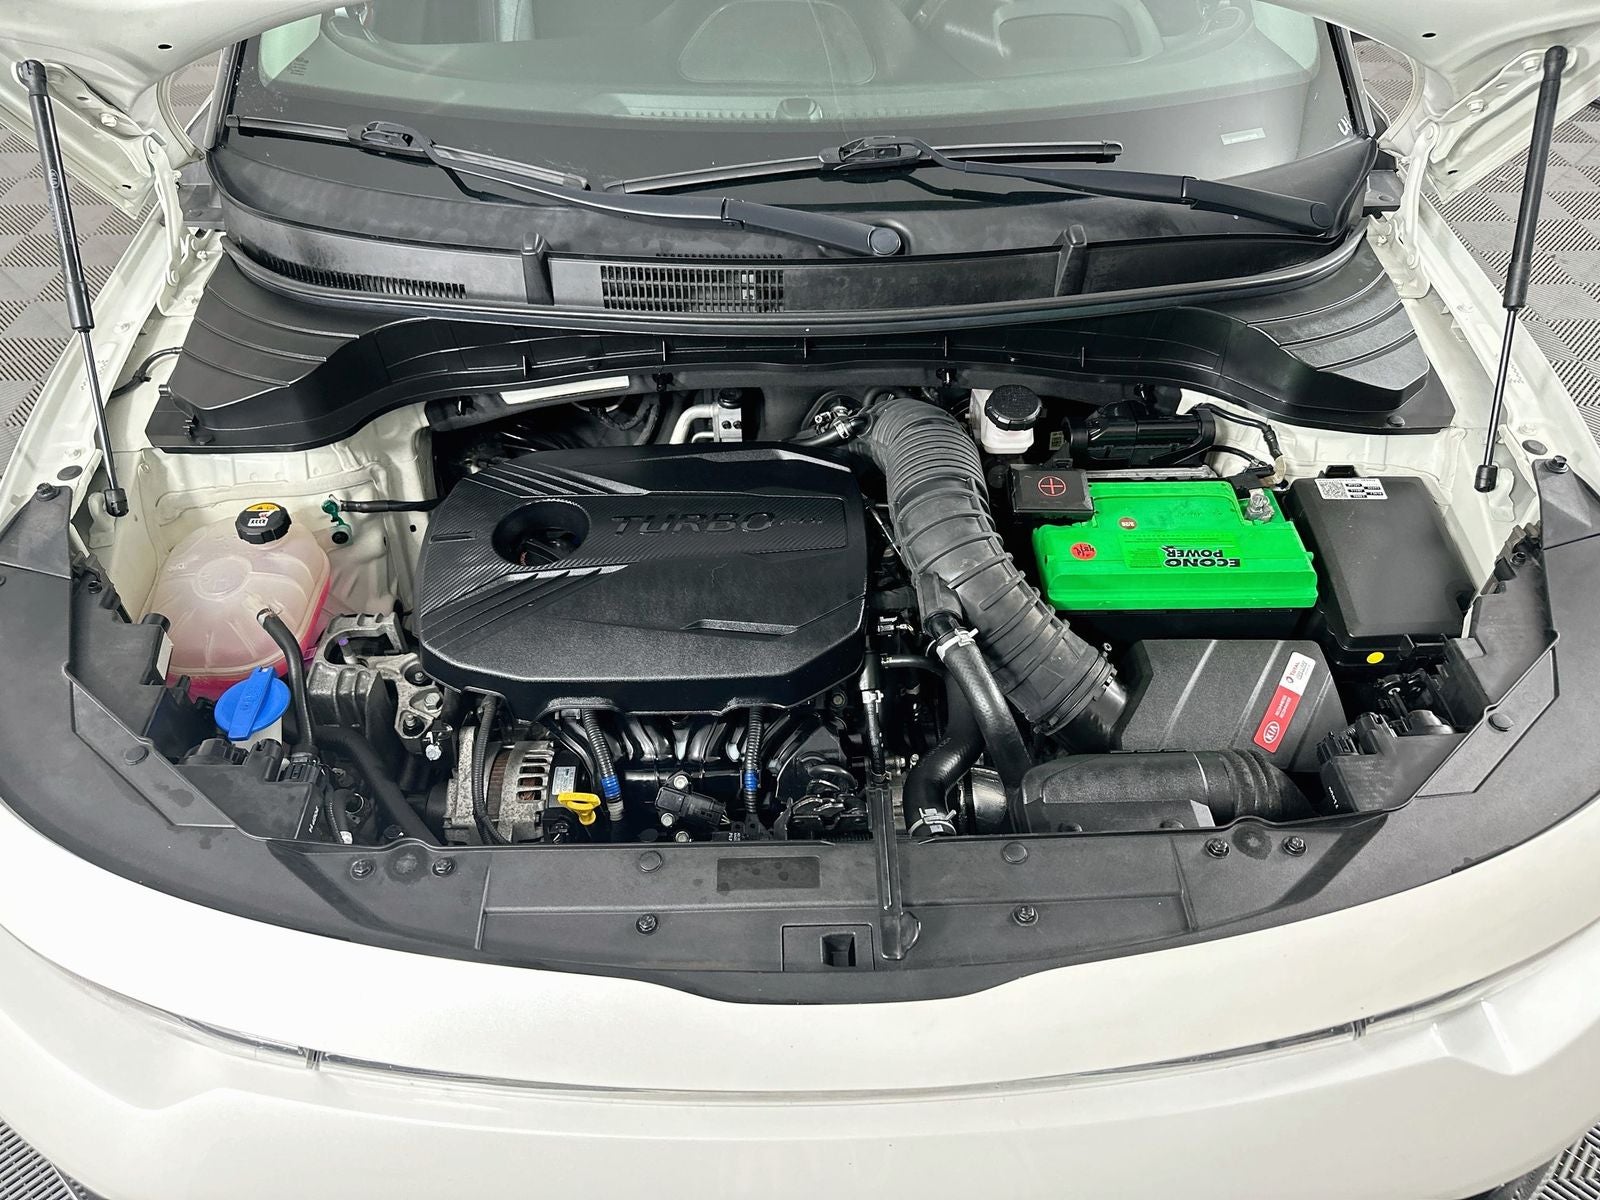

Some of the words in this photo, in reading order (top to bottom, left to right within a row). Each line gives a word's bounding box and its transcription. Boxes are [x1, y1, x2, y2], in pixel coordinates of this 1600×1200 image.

[611, 512, 775, 536] TURBO
[1165, 548, 1223, 558] POWER
[1164, 558, 1241, 568] ECONO
[1290, 662, 1300, 676] TOTAL
[1265, 722, 1279, 742] KIA
